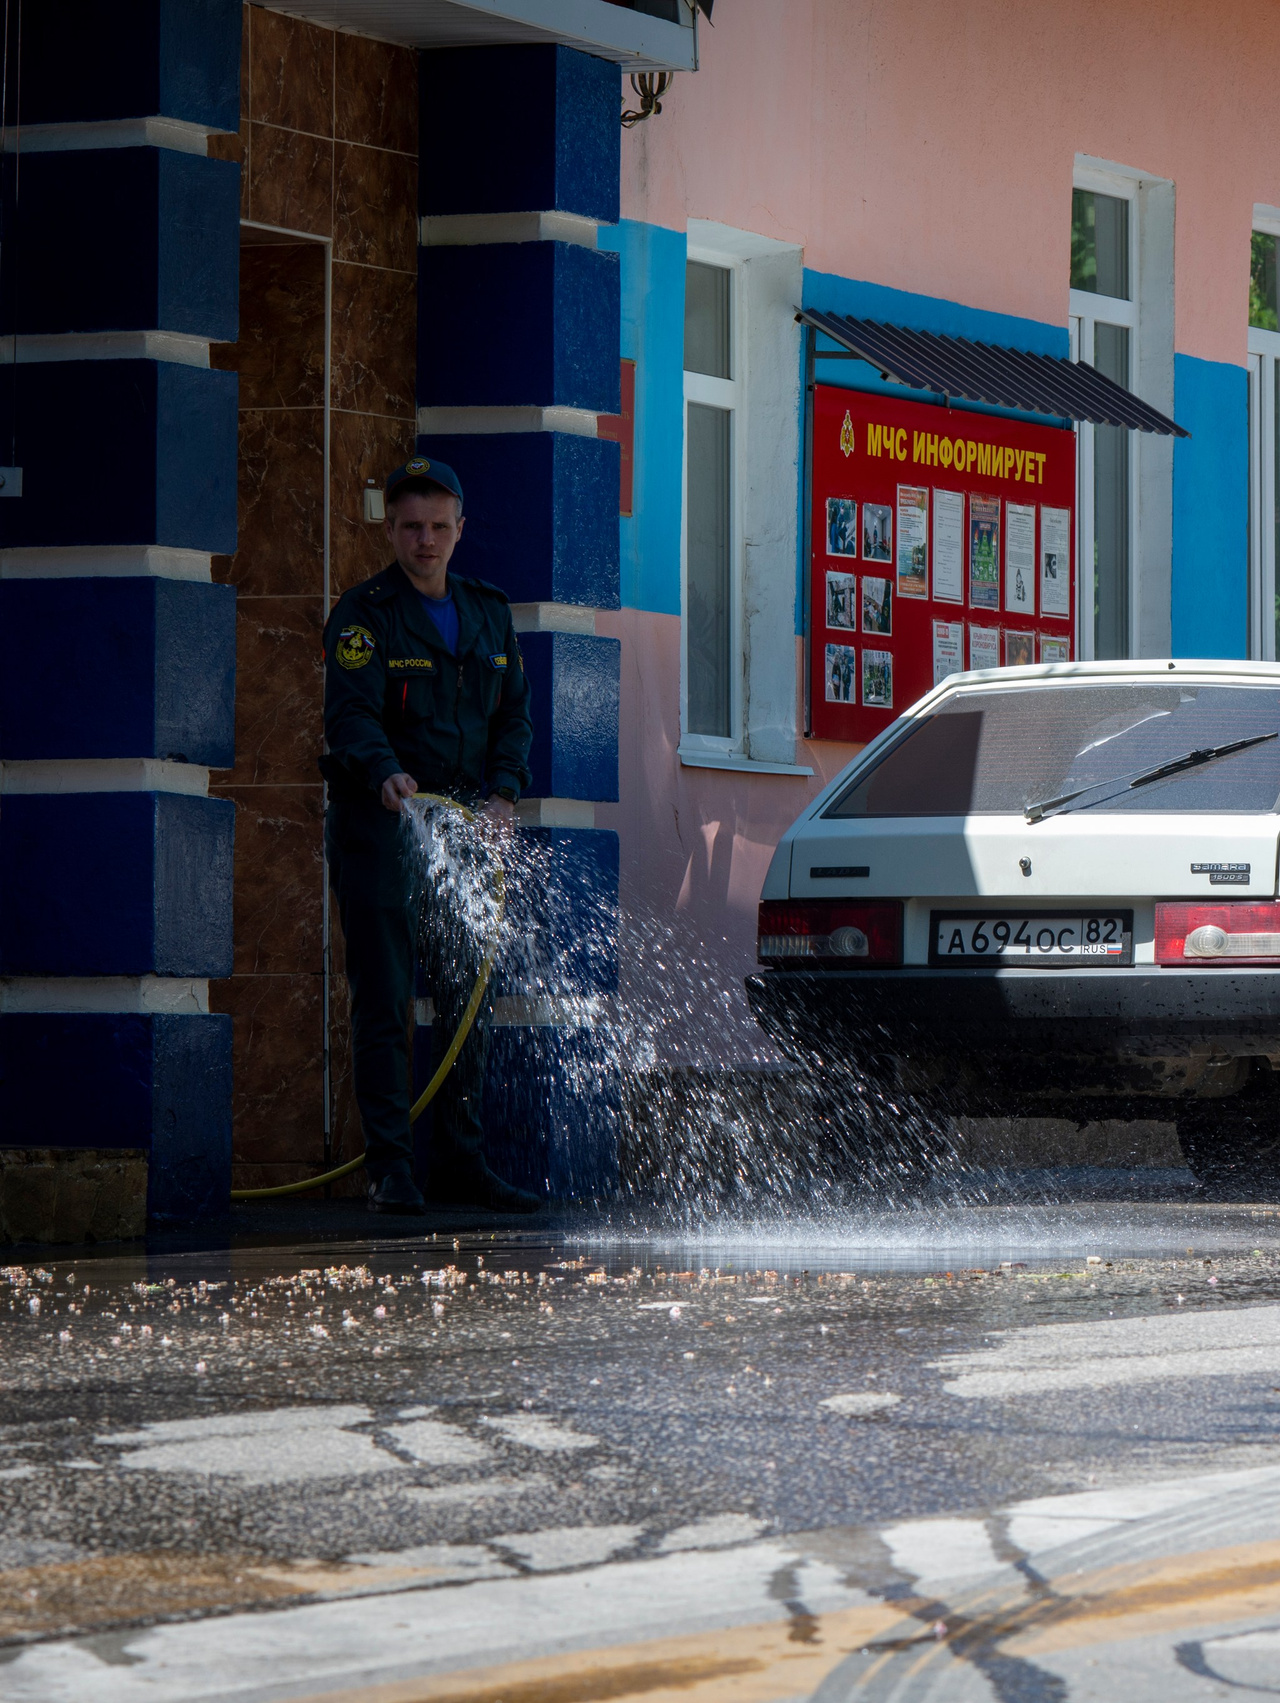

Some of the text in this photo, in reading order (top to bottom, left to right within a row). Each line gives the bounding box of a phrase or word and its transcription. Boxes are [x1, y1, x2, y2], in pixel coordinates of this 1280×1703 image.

[867, 423, 1046, 484] МЧС ИНФОРМИРУЕТ
[388, 658, 433, 669] МЧС РОССИИ
[1086, 918, 1117, 943] 82
[1083, 944, 1106, 954] RUS
